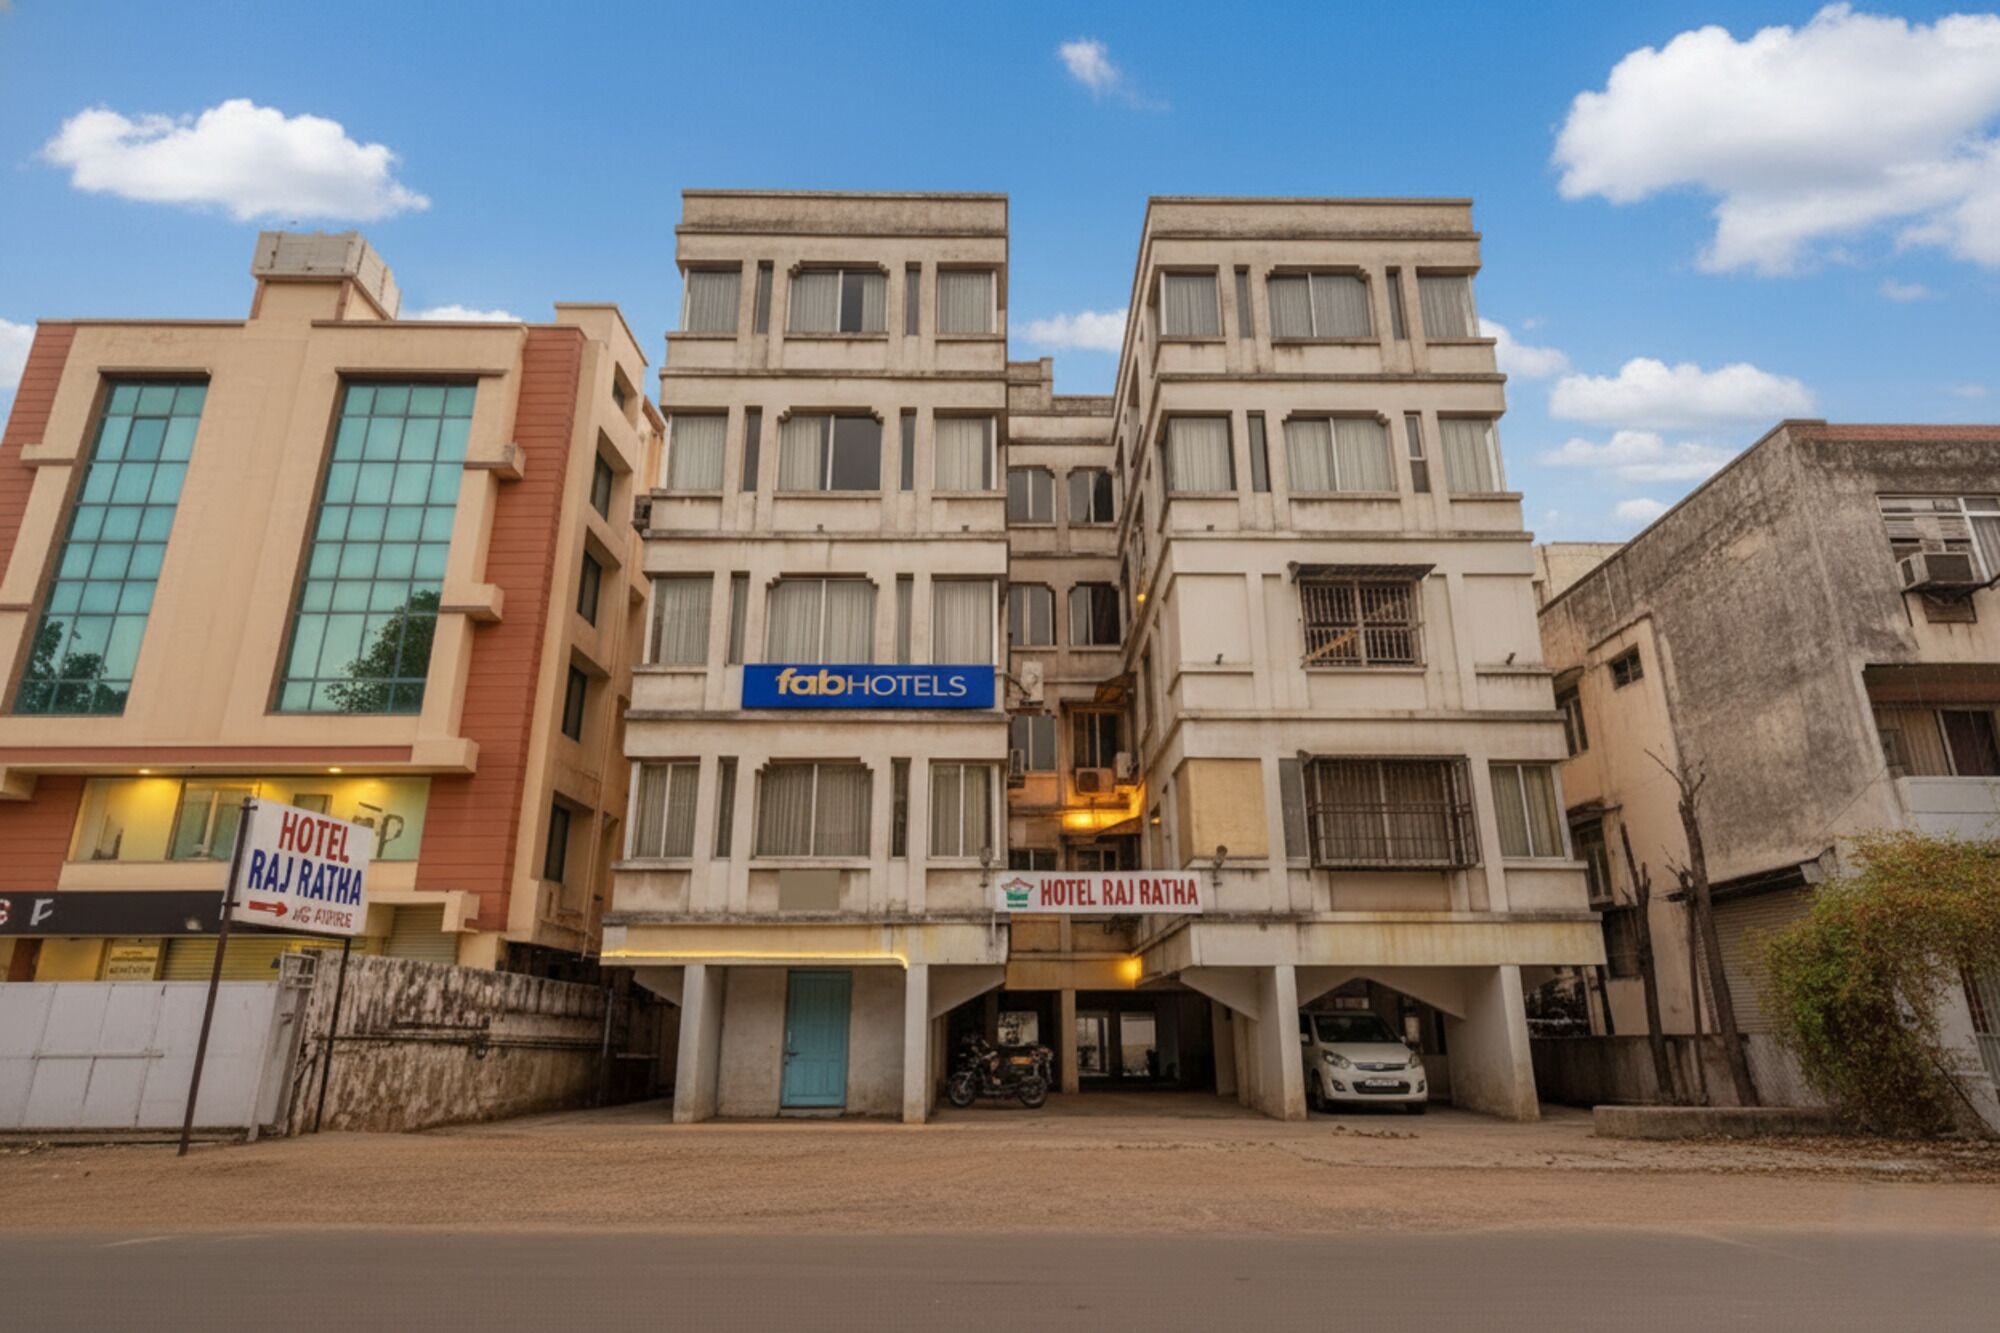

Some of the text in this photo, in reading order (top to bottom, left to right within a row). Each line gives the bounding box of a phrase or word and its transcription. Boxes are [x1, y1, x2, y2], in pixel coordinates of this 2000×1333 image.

[279, 811, 349, 864] HOTEL
[248, 849, 362, 905] RAJ RATHA
[1040, 879, 1199, 906] HOTEL RAJ RATHA
